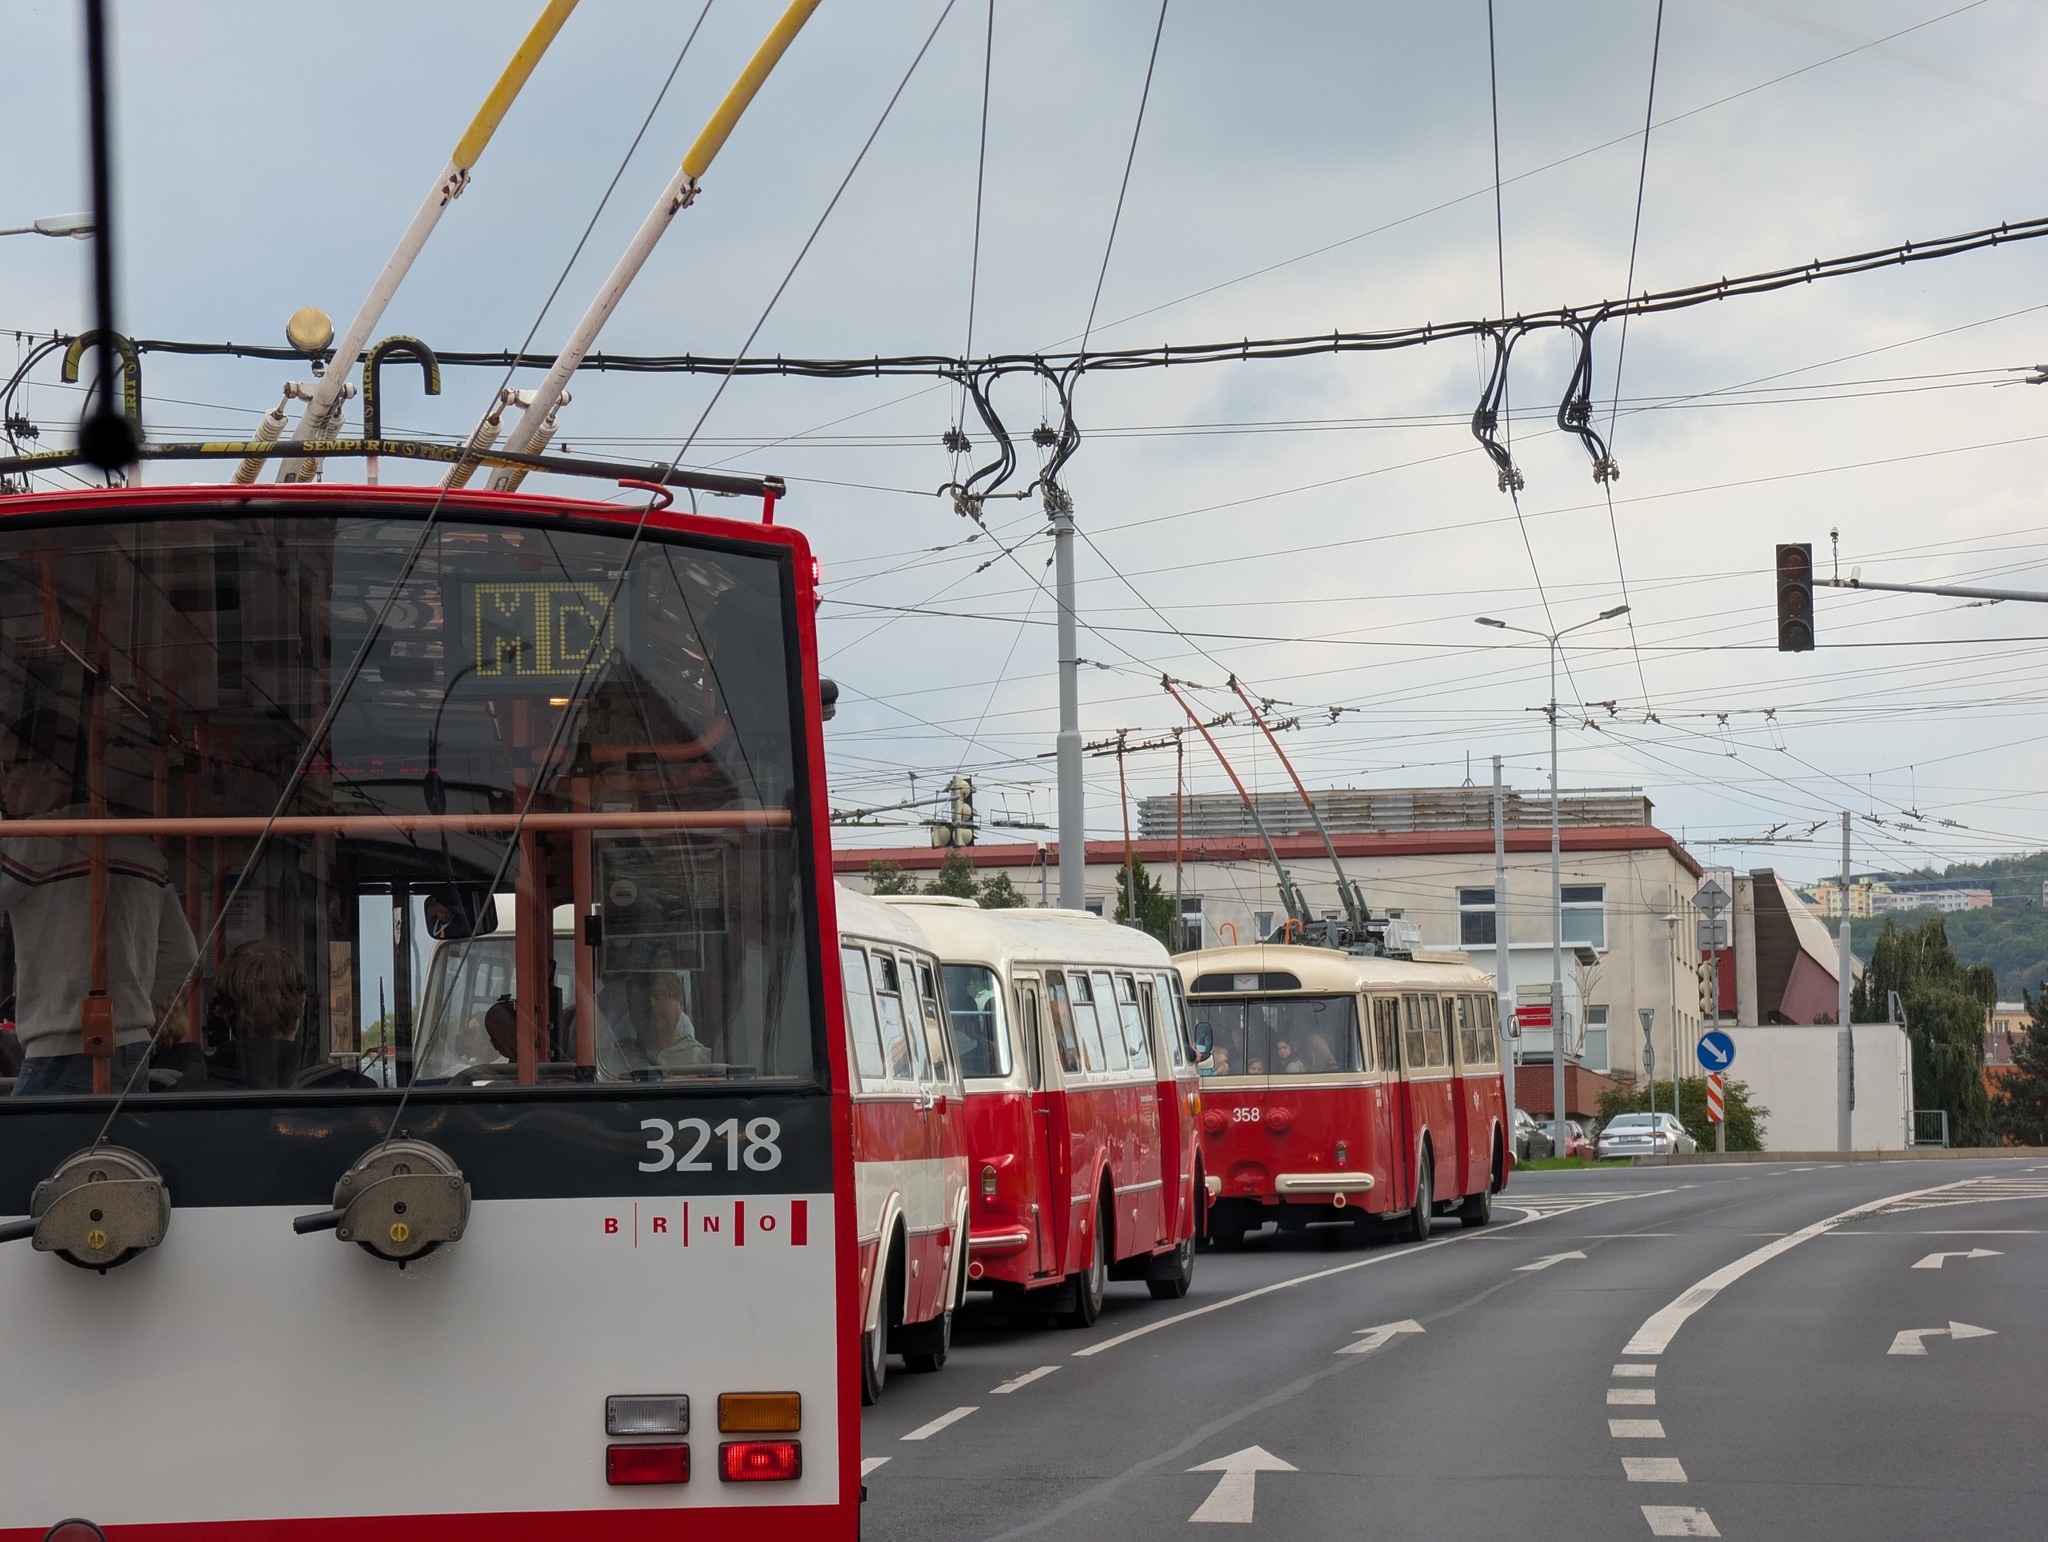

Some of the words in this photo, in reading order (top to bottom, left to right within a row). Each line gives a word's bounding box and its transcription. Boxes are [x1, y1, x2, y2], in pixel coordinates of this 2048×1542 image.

[475, 582, 615, 676] MD
[1232, 1107, 1260, 1122] 358
[638, 1117, 782, 1172] 3218
